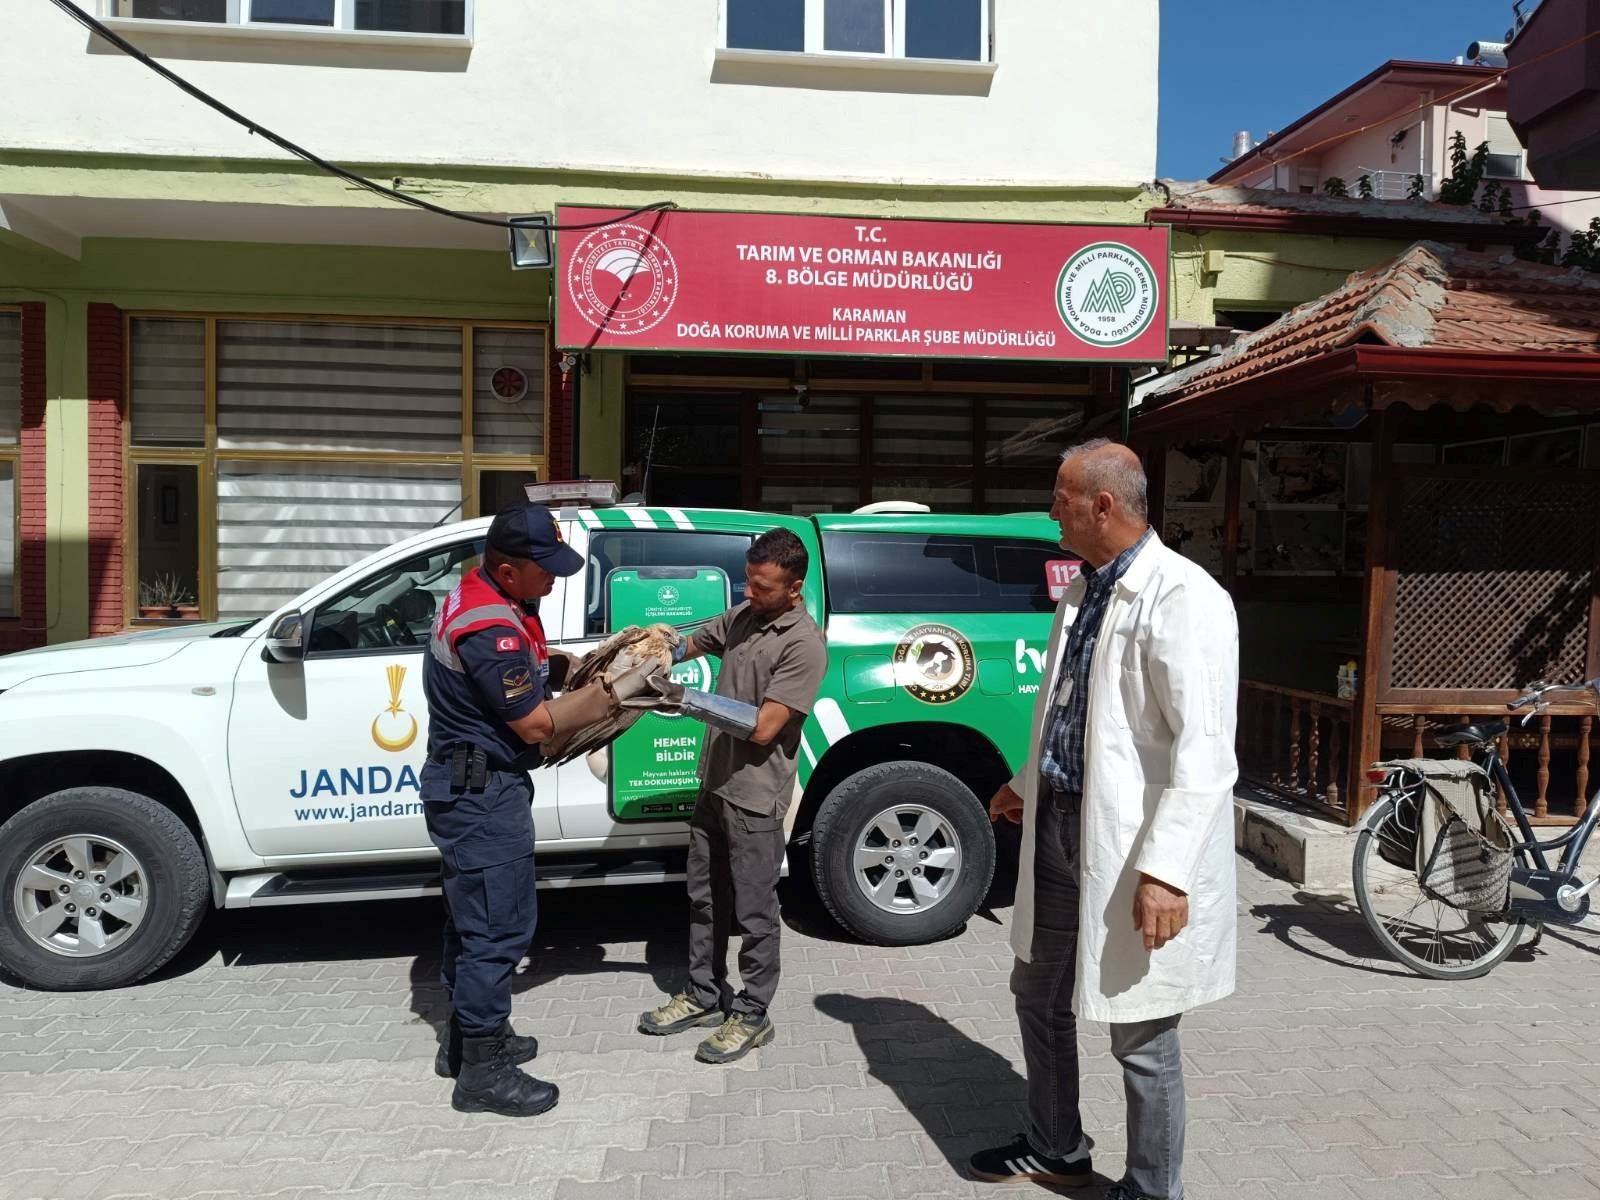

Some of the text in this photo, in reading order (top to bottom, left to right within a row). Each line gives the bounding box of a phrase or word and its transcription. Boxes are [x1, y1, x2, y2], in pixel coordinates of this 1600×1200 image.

[855, 225, 887, 242] T.C.
[736, 244, 1002, 270] TARIM VE ORMAN BAKANLIĞI
[1075, 253, 1096, 272] MİLLİ
[1097, 251, 1135, 268] PARKLAR
[765, 267, 974, 292] 8. BÖLGE MÜDÜRLÜĞÜ
[1067, 271, 1077, 283] VE
[1134, 266, 1149, 295] GENEL
[1065, 285, 1080, 322] KORUMA
[832, 307, 906, 324] KARAMAN
[677, 321, 1056, 348] DOĞA KORUMA VE MİLLİ PARKLAR ŞUBE MÜDÜRLÜĞÜ
[1079, 321, 1102, 337] DOĞA
[653, 736, 697, 748] HEMEN
[656, 749, 695, 762] BİLDİR
[642, 771, 668, 779] Hayvan
[644, 778, 694, 787] DOKUNUŞUN
